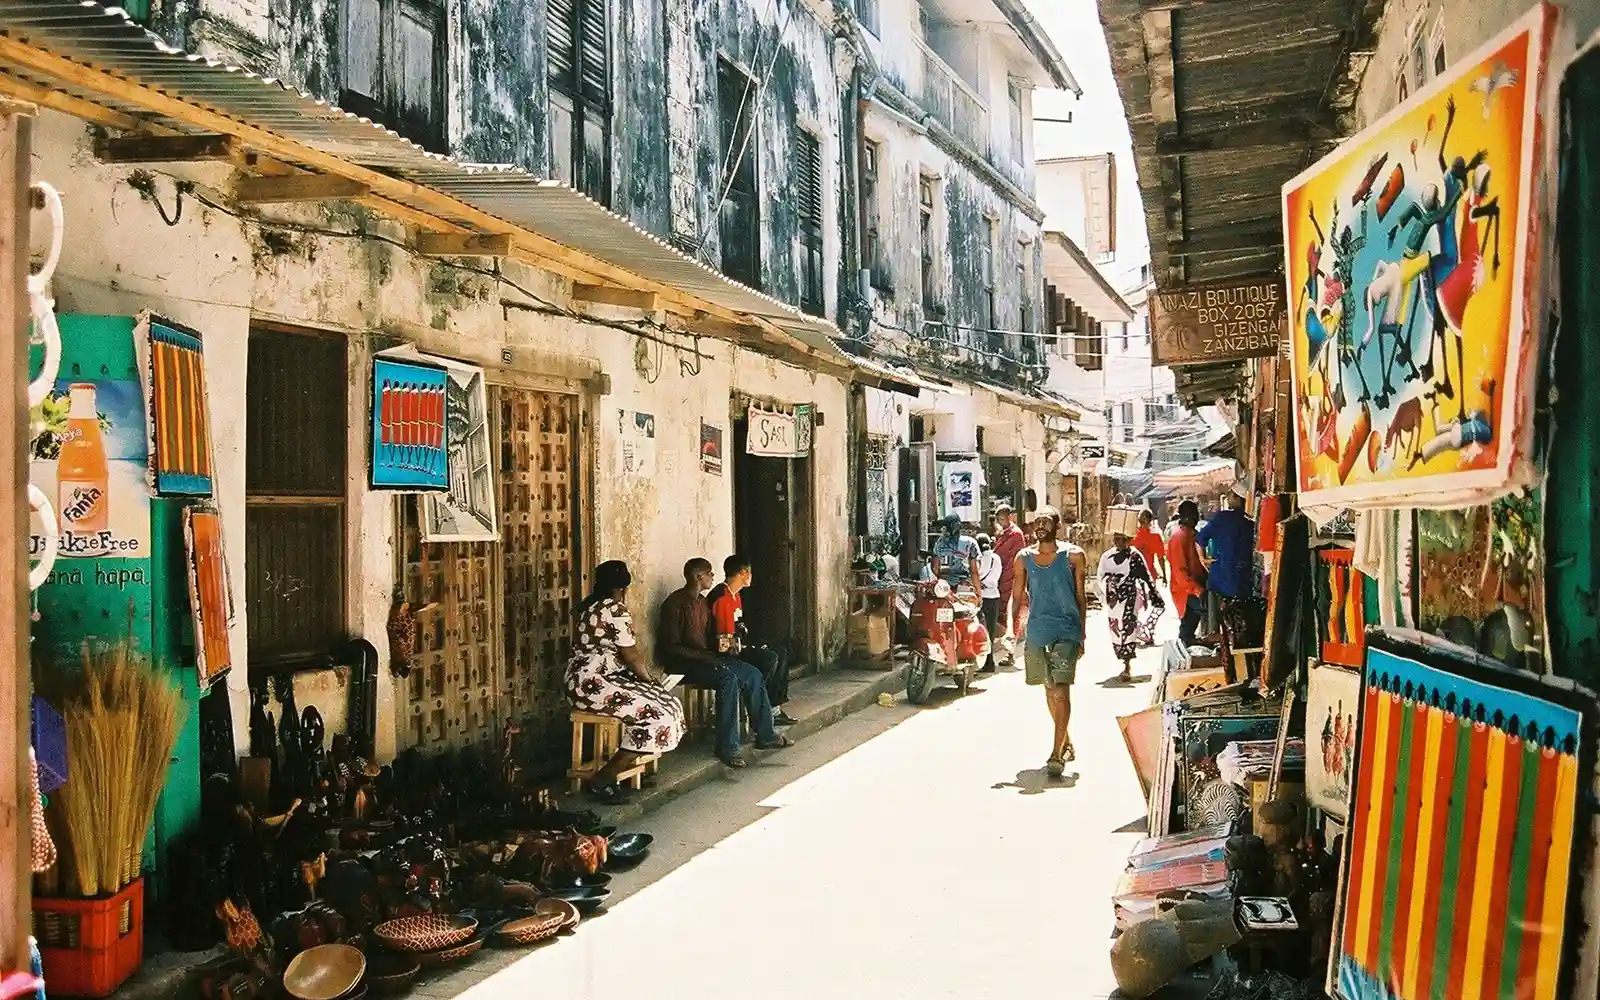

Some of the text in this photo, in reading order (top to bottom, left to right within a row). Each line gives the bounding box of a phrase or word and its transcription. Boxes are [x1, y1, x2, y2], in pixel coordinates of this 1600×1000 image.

[1206, 284, 1279, 307] BOUTIQUE
[1198, 302, 1276, 324] BOX 2067
[1214, 320, 1279, 337] GIZENGA
[63, 487, 103, 524] Fanta
[29, 531, 139, 554] JiikieFree
